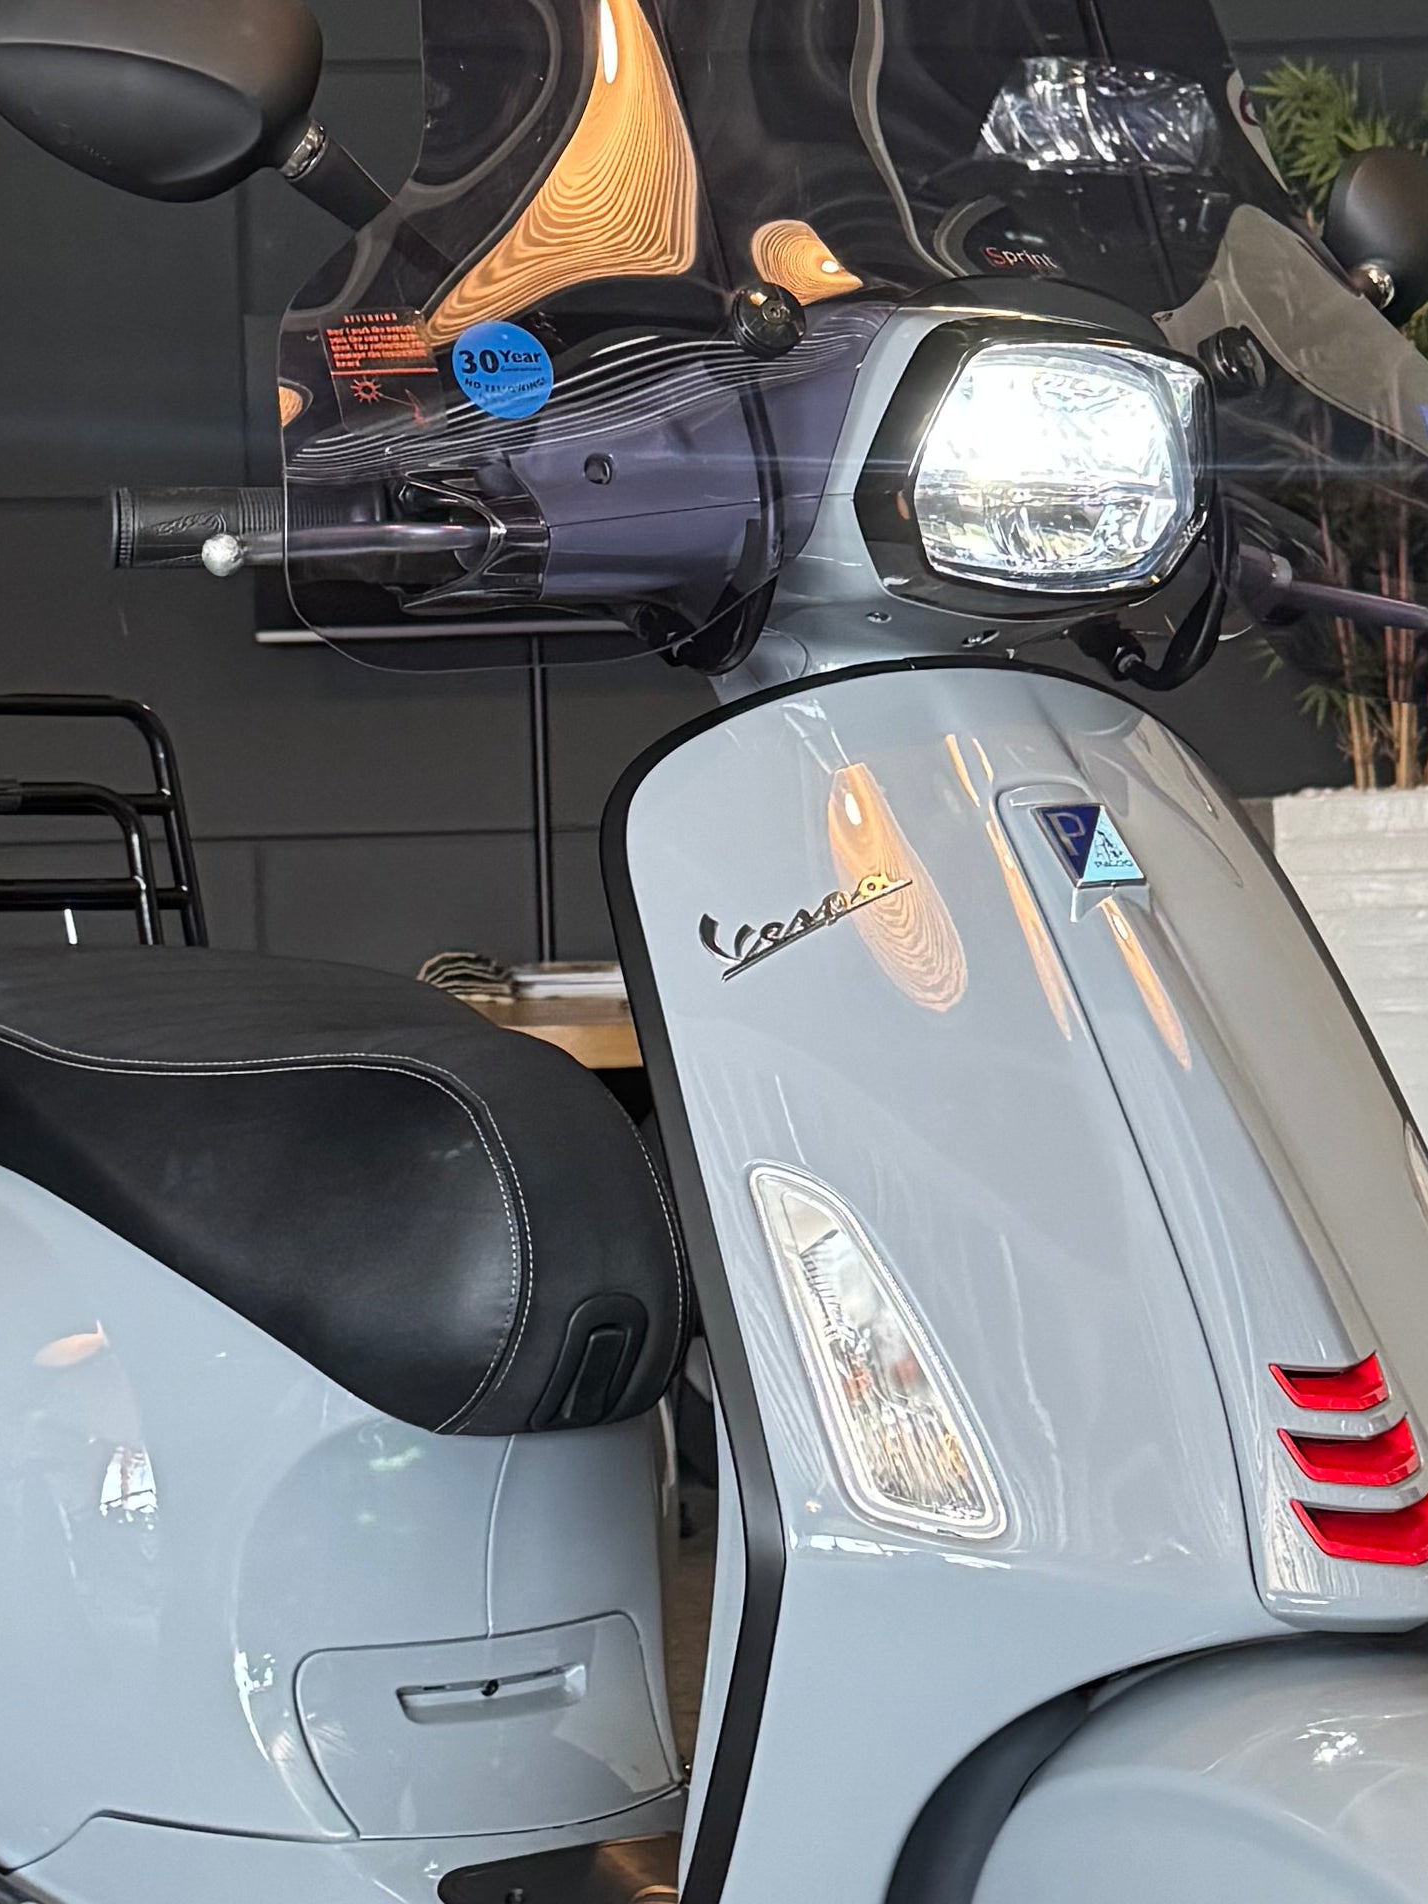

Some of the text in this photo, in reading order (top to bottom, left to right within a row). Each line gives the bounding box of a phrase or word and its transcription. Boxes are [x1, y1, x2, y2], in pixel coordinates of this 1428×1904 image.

[984, 246, 1059, 269] Sprint
[458, 349, 542, 374] 30 Year
[698, 872, 913, 983] Vespa
